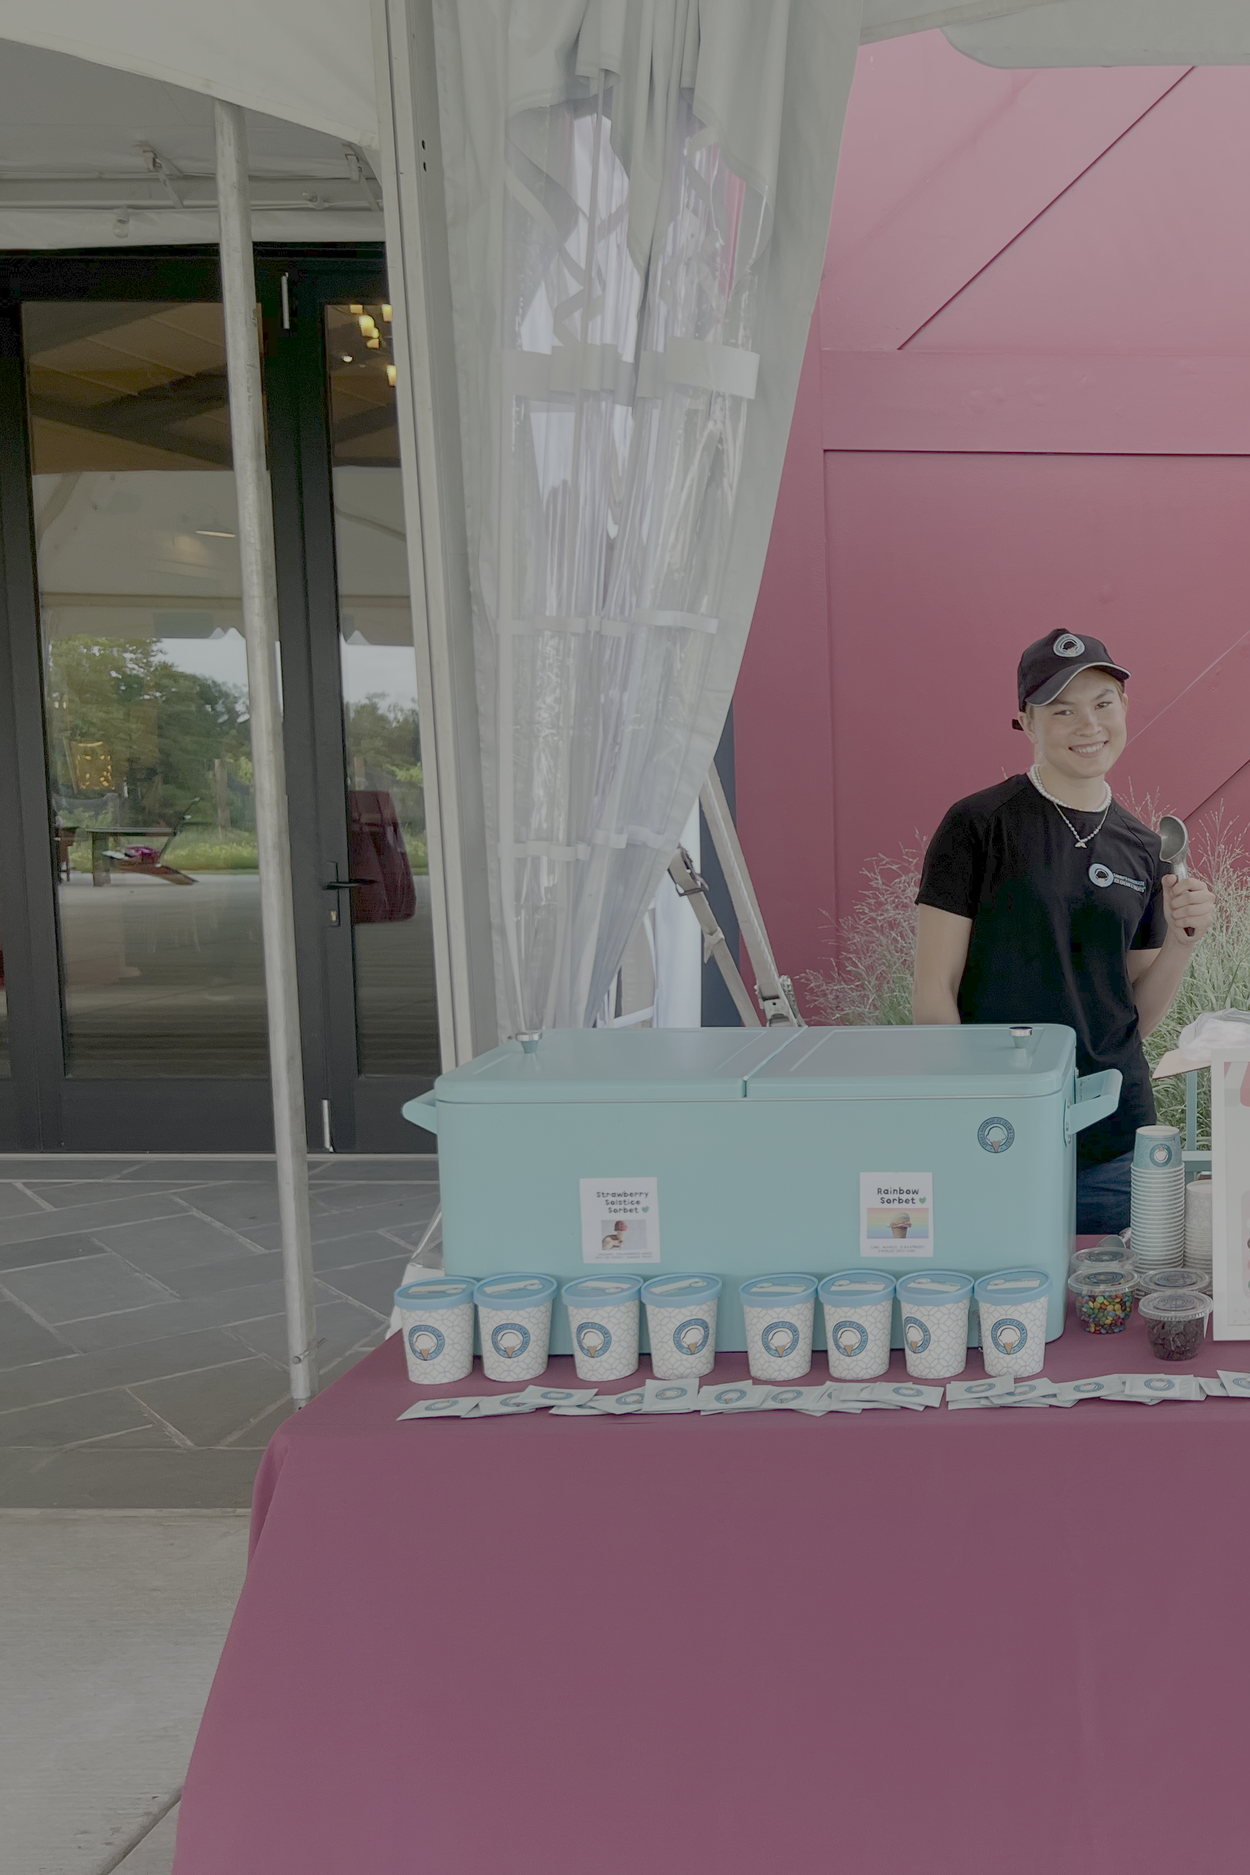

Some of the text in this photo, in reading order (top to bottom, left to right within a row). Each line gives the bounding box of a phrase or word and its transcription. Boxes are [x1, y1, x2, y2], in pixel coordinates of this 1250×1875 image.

[596, 1190, 649, 1198] Strawberry
[877, 1187, 920, 1196] Rainbow
[880, 1196, 916, 1205] Sorbet
[608, 1206, 639, 1214] Sorbet
